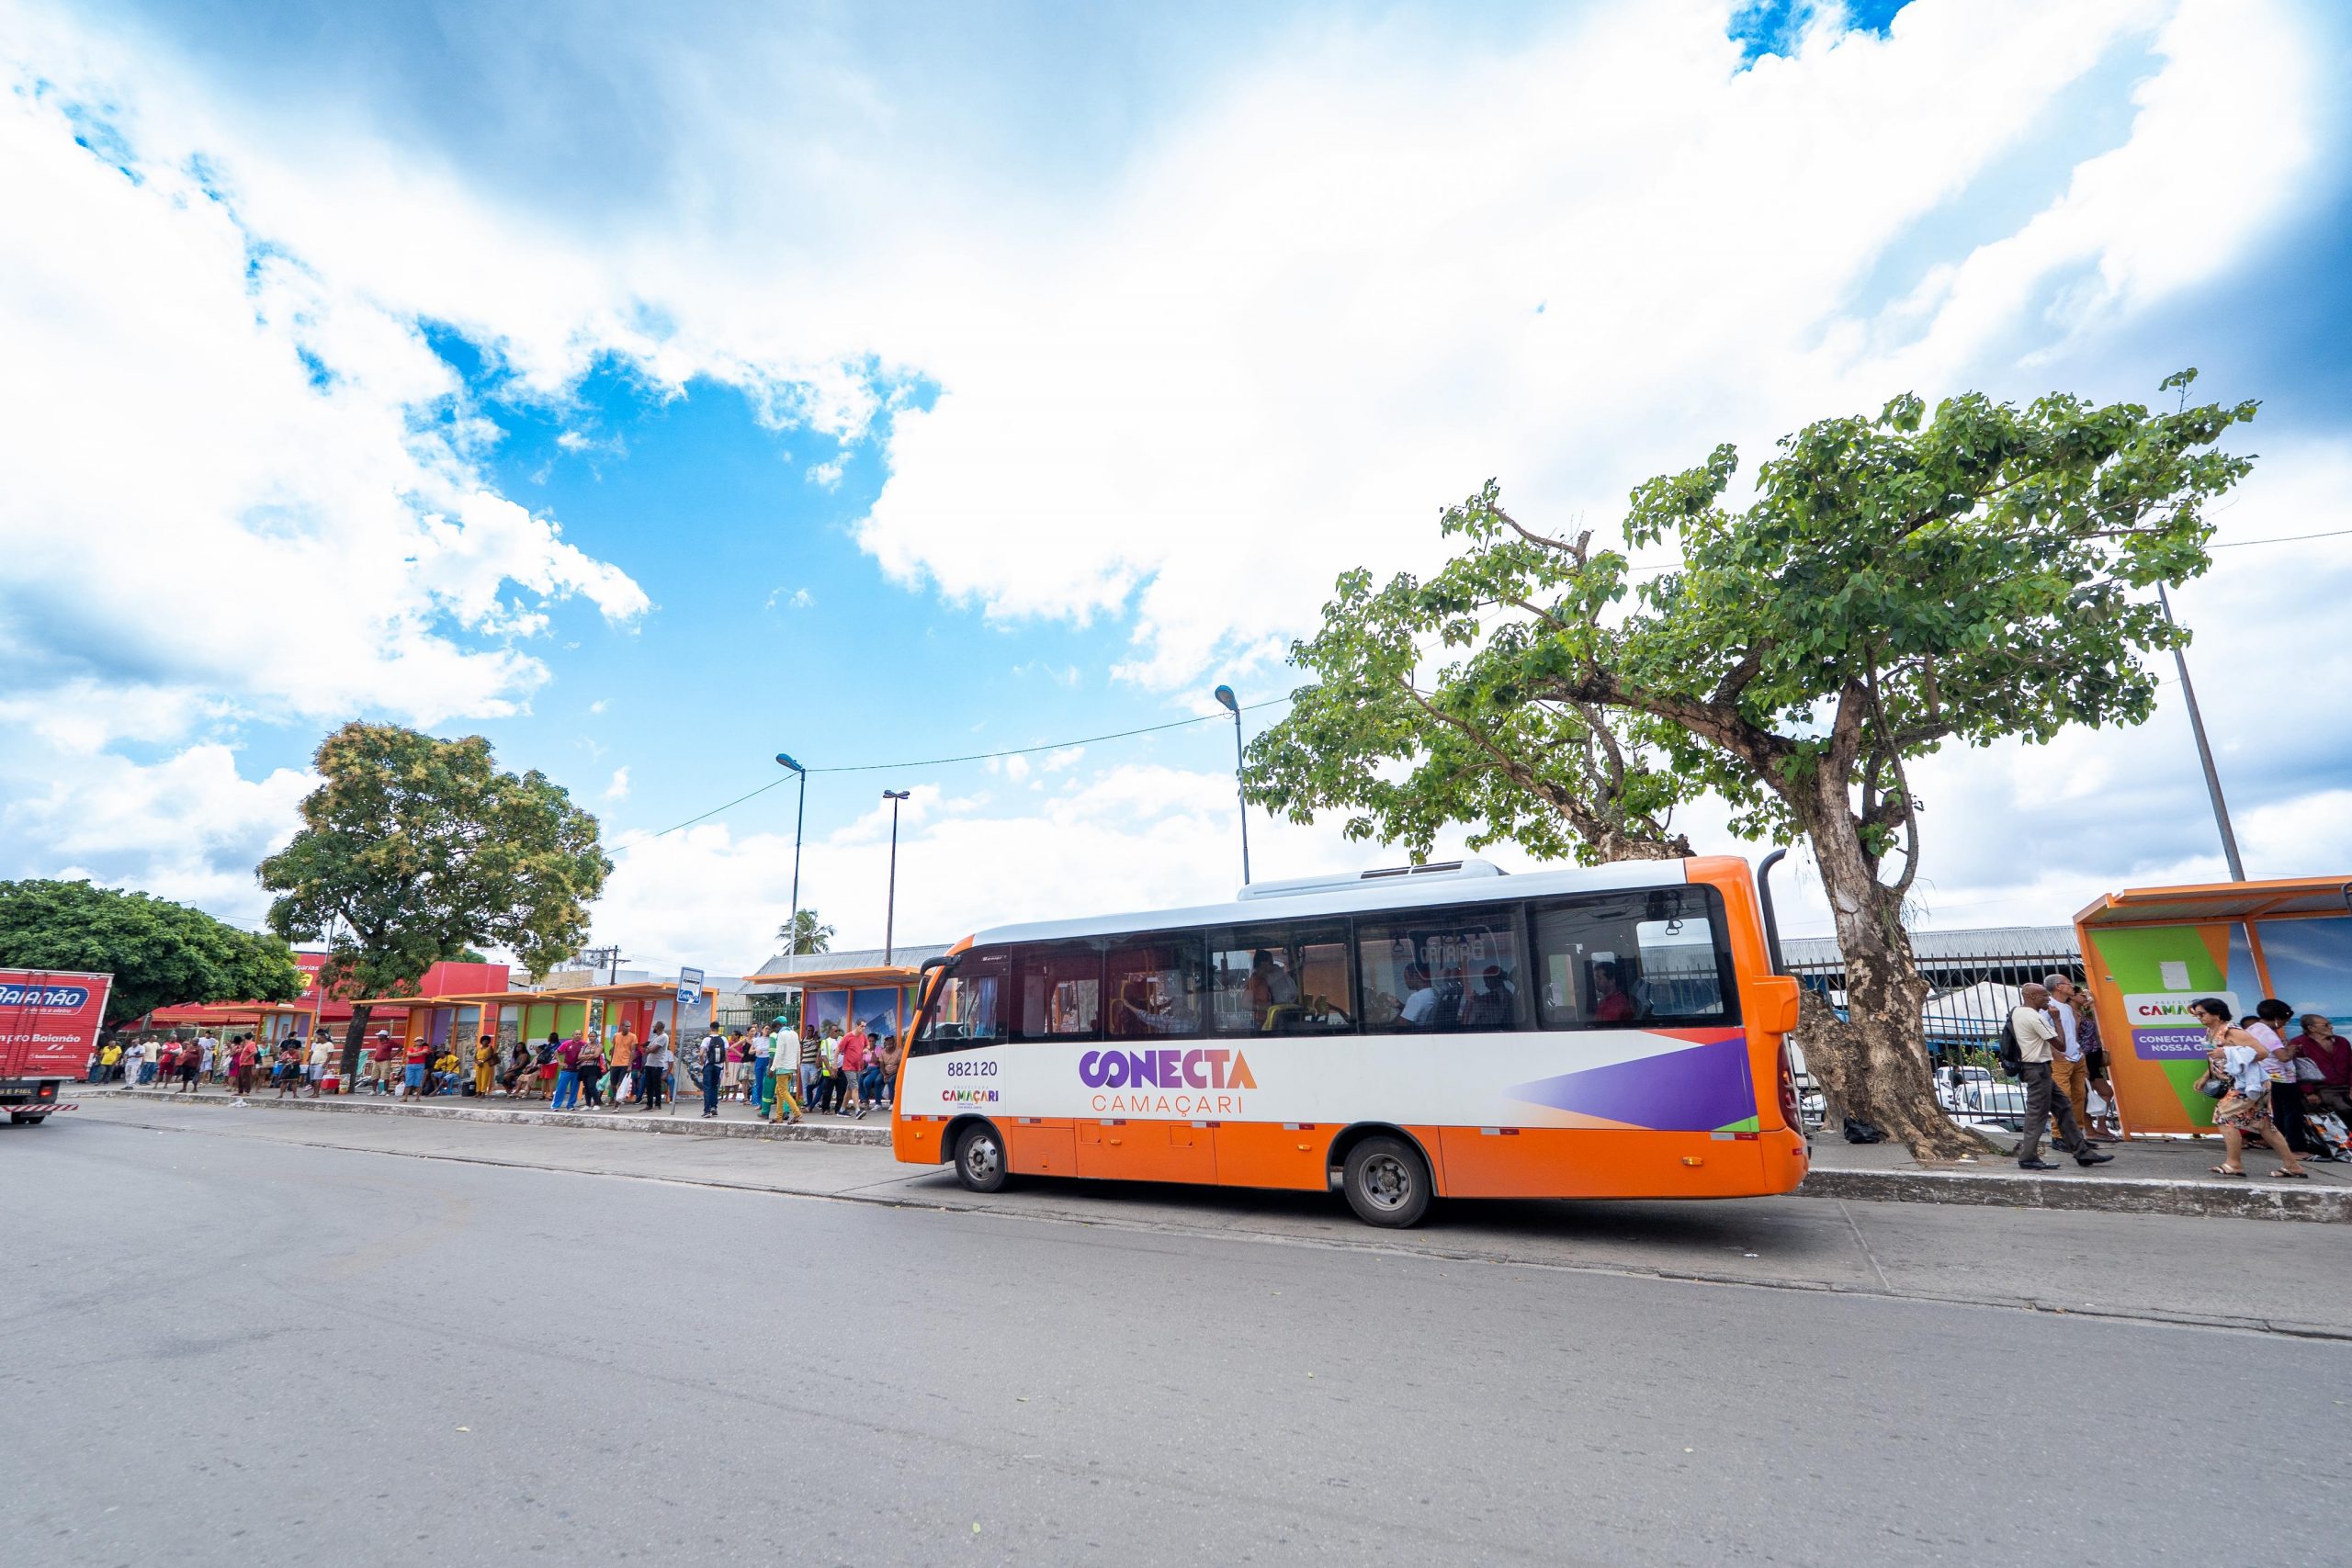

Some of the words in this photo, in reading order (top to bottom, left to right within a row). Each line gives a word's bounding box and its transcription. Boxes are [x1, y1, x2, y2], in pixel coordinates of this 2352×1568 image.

[32, 1034, 81, 1043] Baianão
[947, 1062, 997, 1076] 882120
[1079, 1049, 1258, 1089] CONECTA
[942, 1089, 999, 1104] CAMAÇARI
[1092, 1095, 1241, 1117] CAMAÇARI
